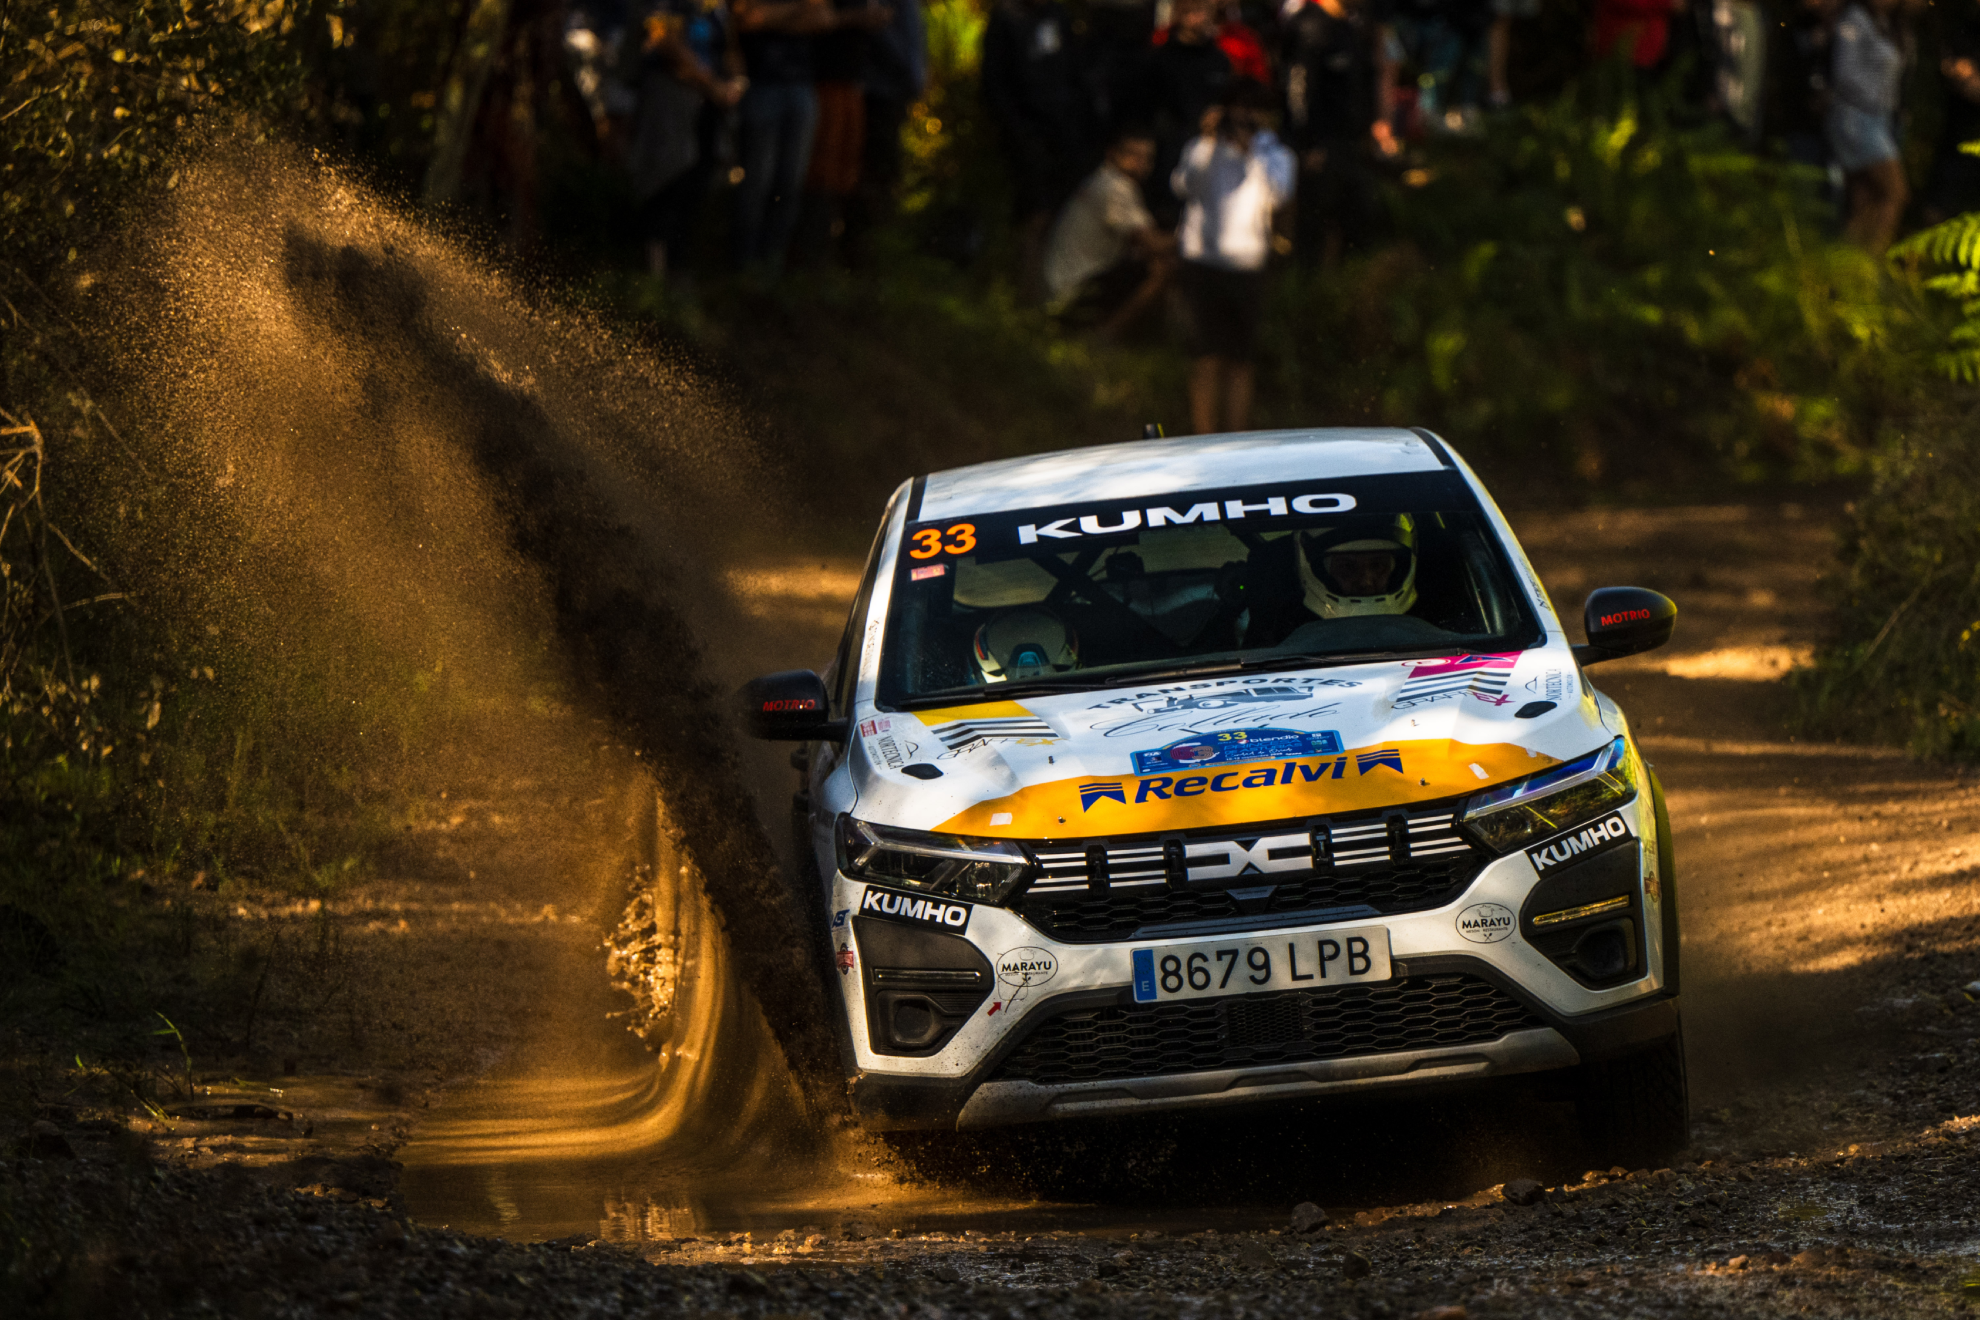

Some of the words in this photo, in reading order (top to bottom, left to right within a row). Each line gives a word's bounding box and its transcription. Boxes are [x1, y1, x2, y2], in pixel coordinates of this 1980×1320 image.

[1018, 493, 1357, 545] KUMHO
[909, 523, 977, 560] 33
[1600, 608, 1650, 627] MOTRIO
[762, 699, 816, 712] MOTRIO
[1087, 677, 1363, 710] TRANSPORTES
[1217, 731, 1248, 742] 33
[1249, 734, 1300, 743] blendio
[1134, 756, 1349, 804] Recalvi
[1531, 816, 1626, 871] KUMHO
[863, 890, 967, 927] KUMHO
[1461, 916, 1511, 930] MARAYU
[1001, 960, 1053, 972] MARAYU
[1160, 946, 1272, 994] 8679
[1288, 936, 1372, 982] LPB
[1142, 981, 1150, 992] E
